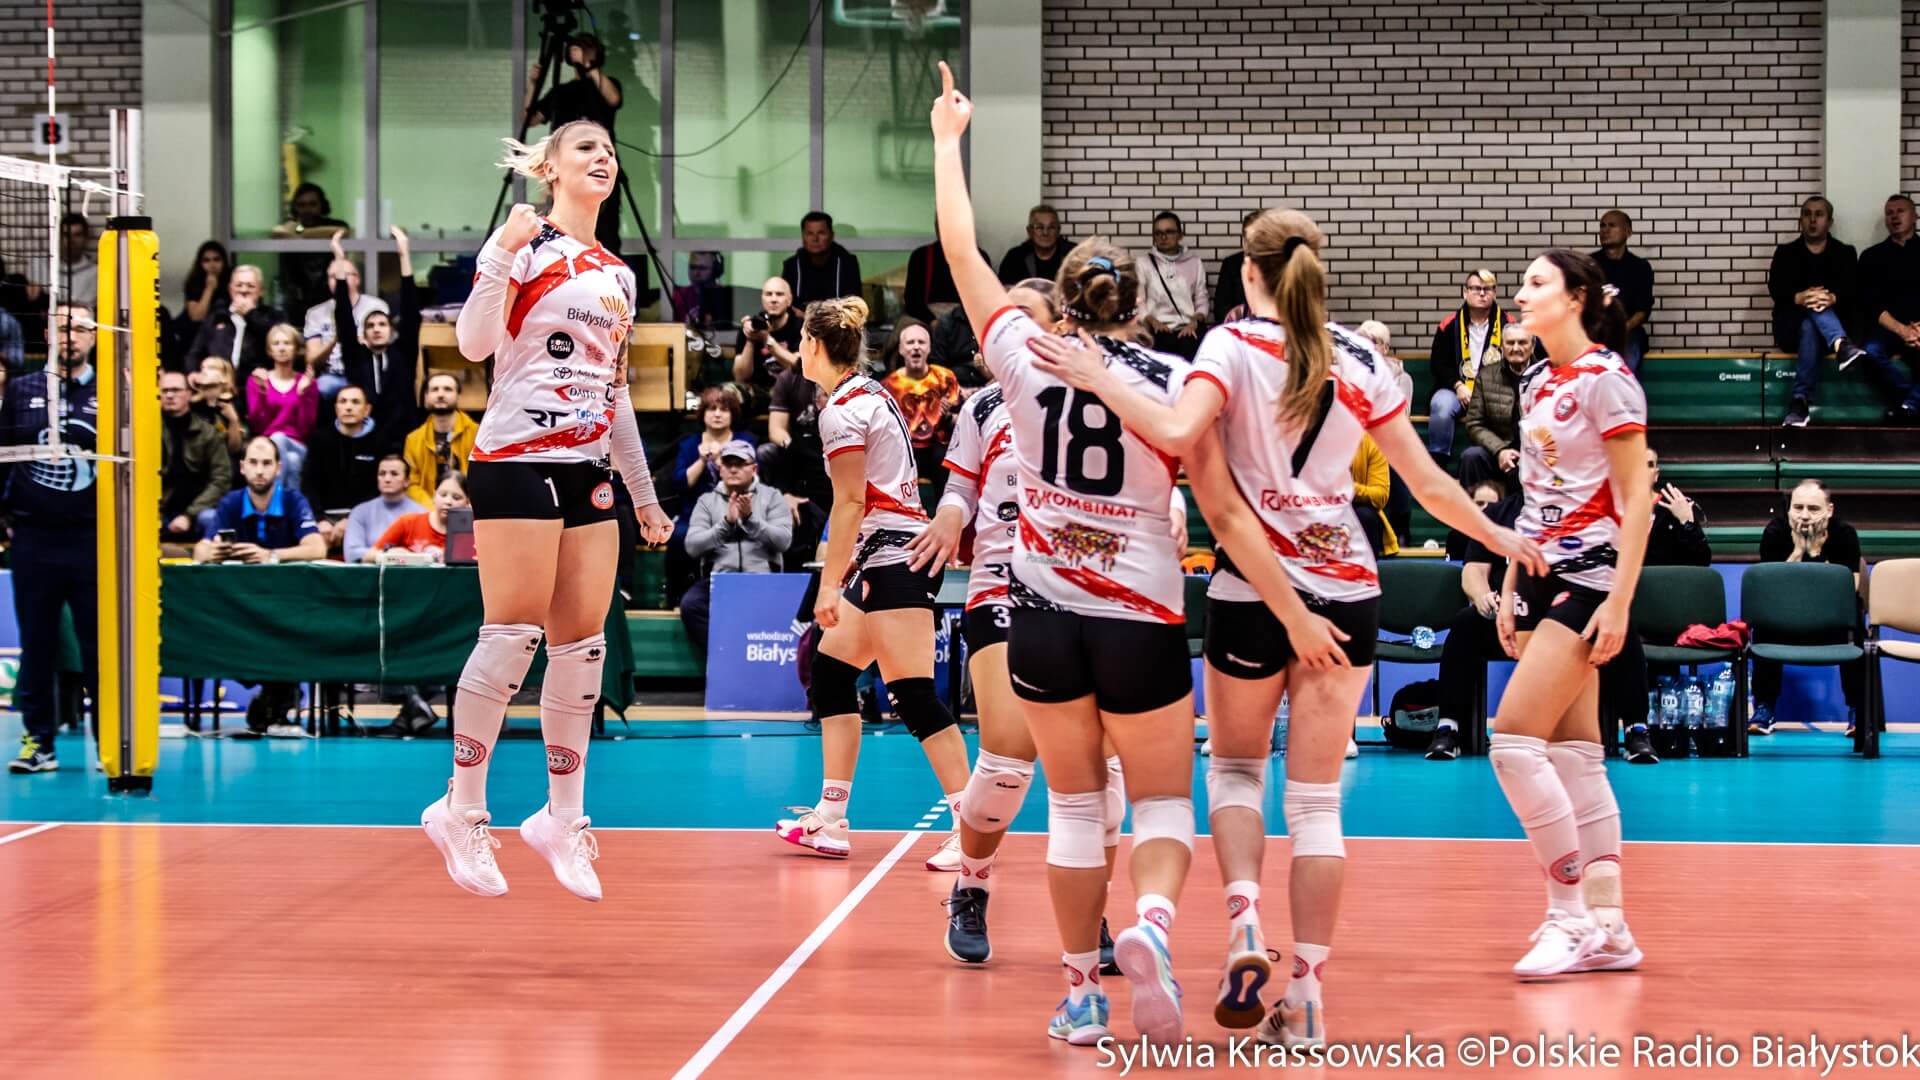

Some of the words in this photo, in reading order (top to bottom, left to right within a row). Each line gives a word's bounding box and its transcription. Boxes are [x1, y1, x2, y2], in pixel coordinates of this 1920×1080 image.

[567, 307, 615, 330] Białystok
[569, 387, 597, 399] DAITO
[523, 408, 570, 428] RT
[1035, 386, 1125, 497] 18
[544, 476, 560, 508] 1
[1042, 489, 1137, 518] KOMBINAT
[992, 606, 1011, 628] 3
[746, 643, 797, 666] Białys
